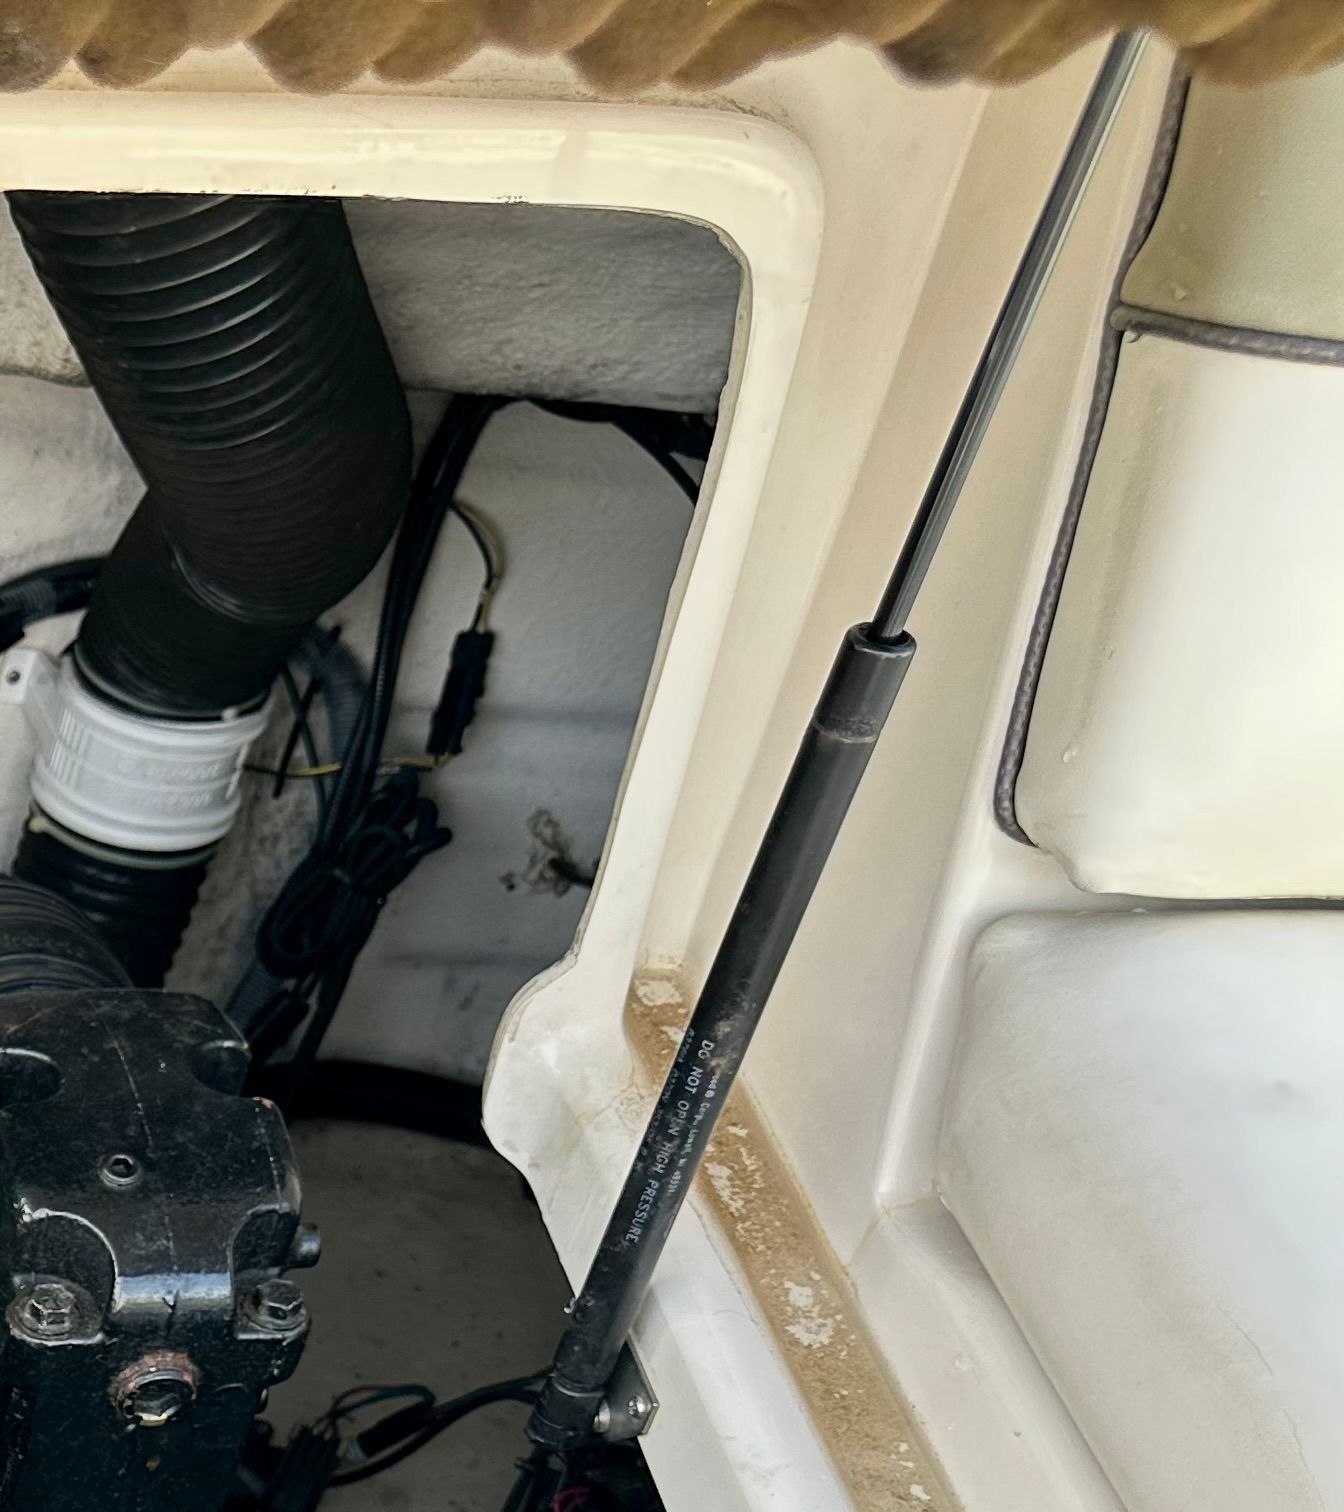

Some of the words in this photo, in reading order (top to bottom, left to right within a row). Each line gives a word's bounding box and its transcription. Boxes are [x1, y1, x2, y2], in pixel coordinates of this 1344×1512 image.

[697, 1039, 715, 1059] DO
[684, 1065, 704, 1094] NOT
[652, 1141, 673, 1174] HIGH
[625, 1179, 660, 1243] PRESSURE
